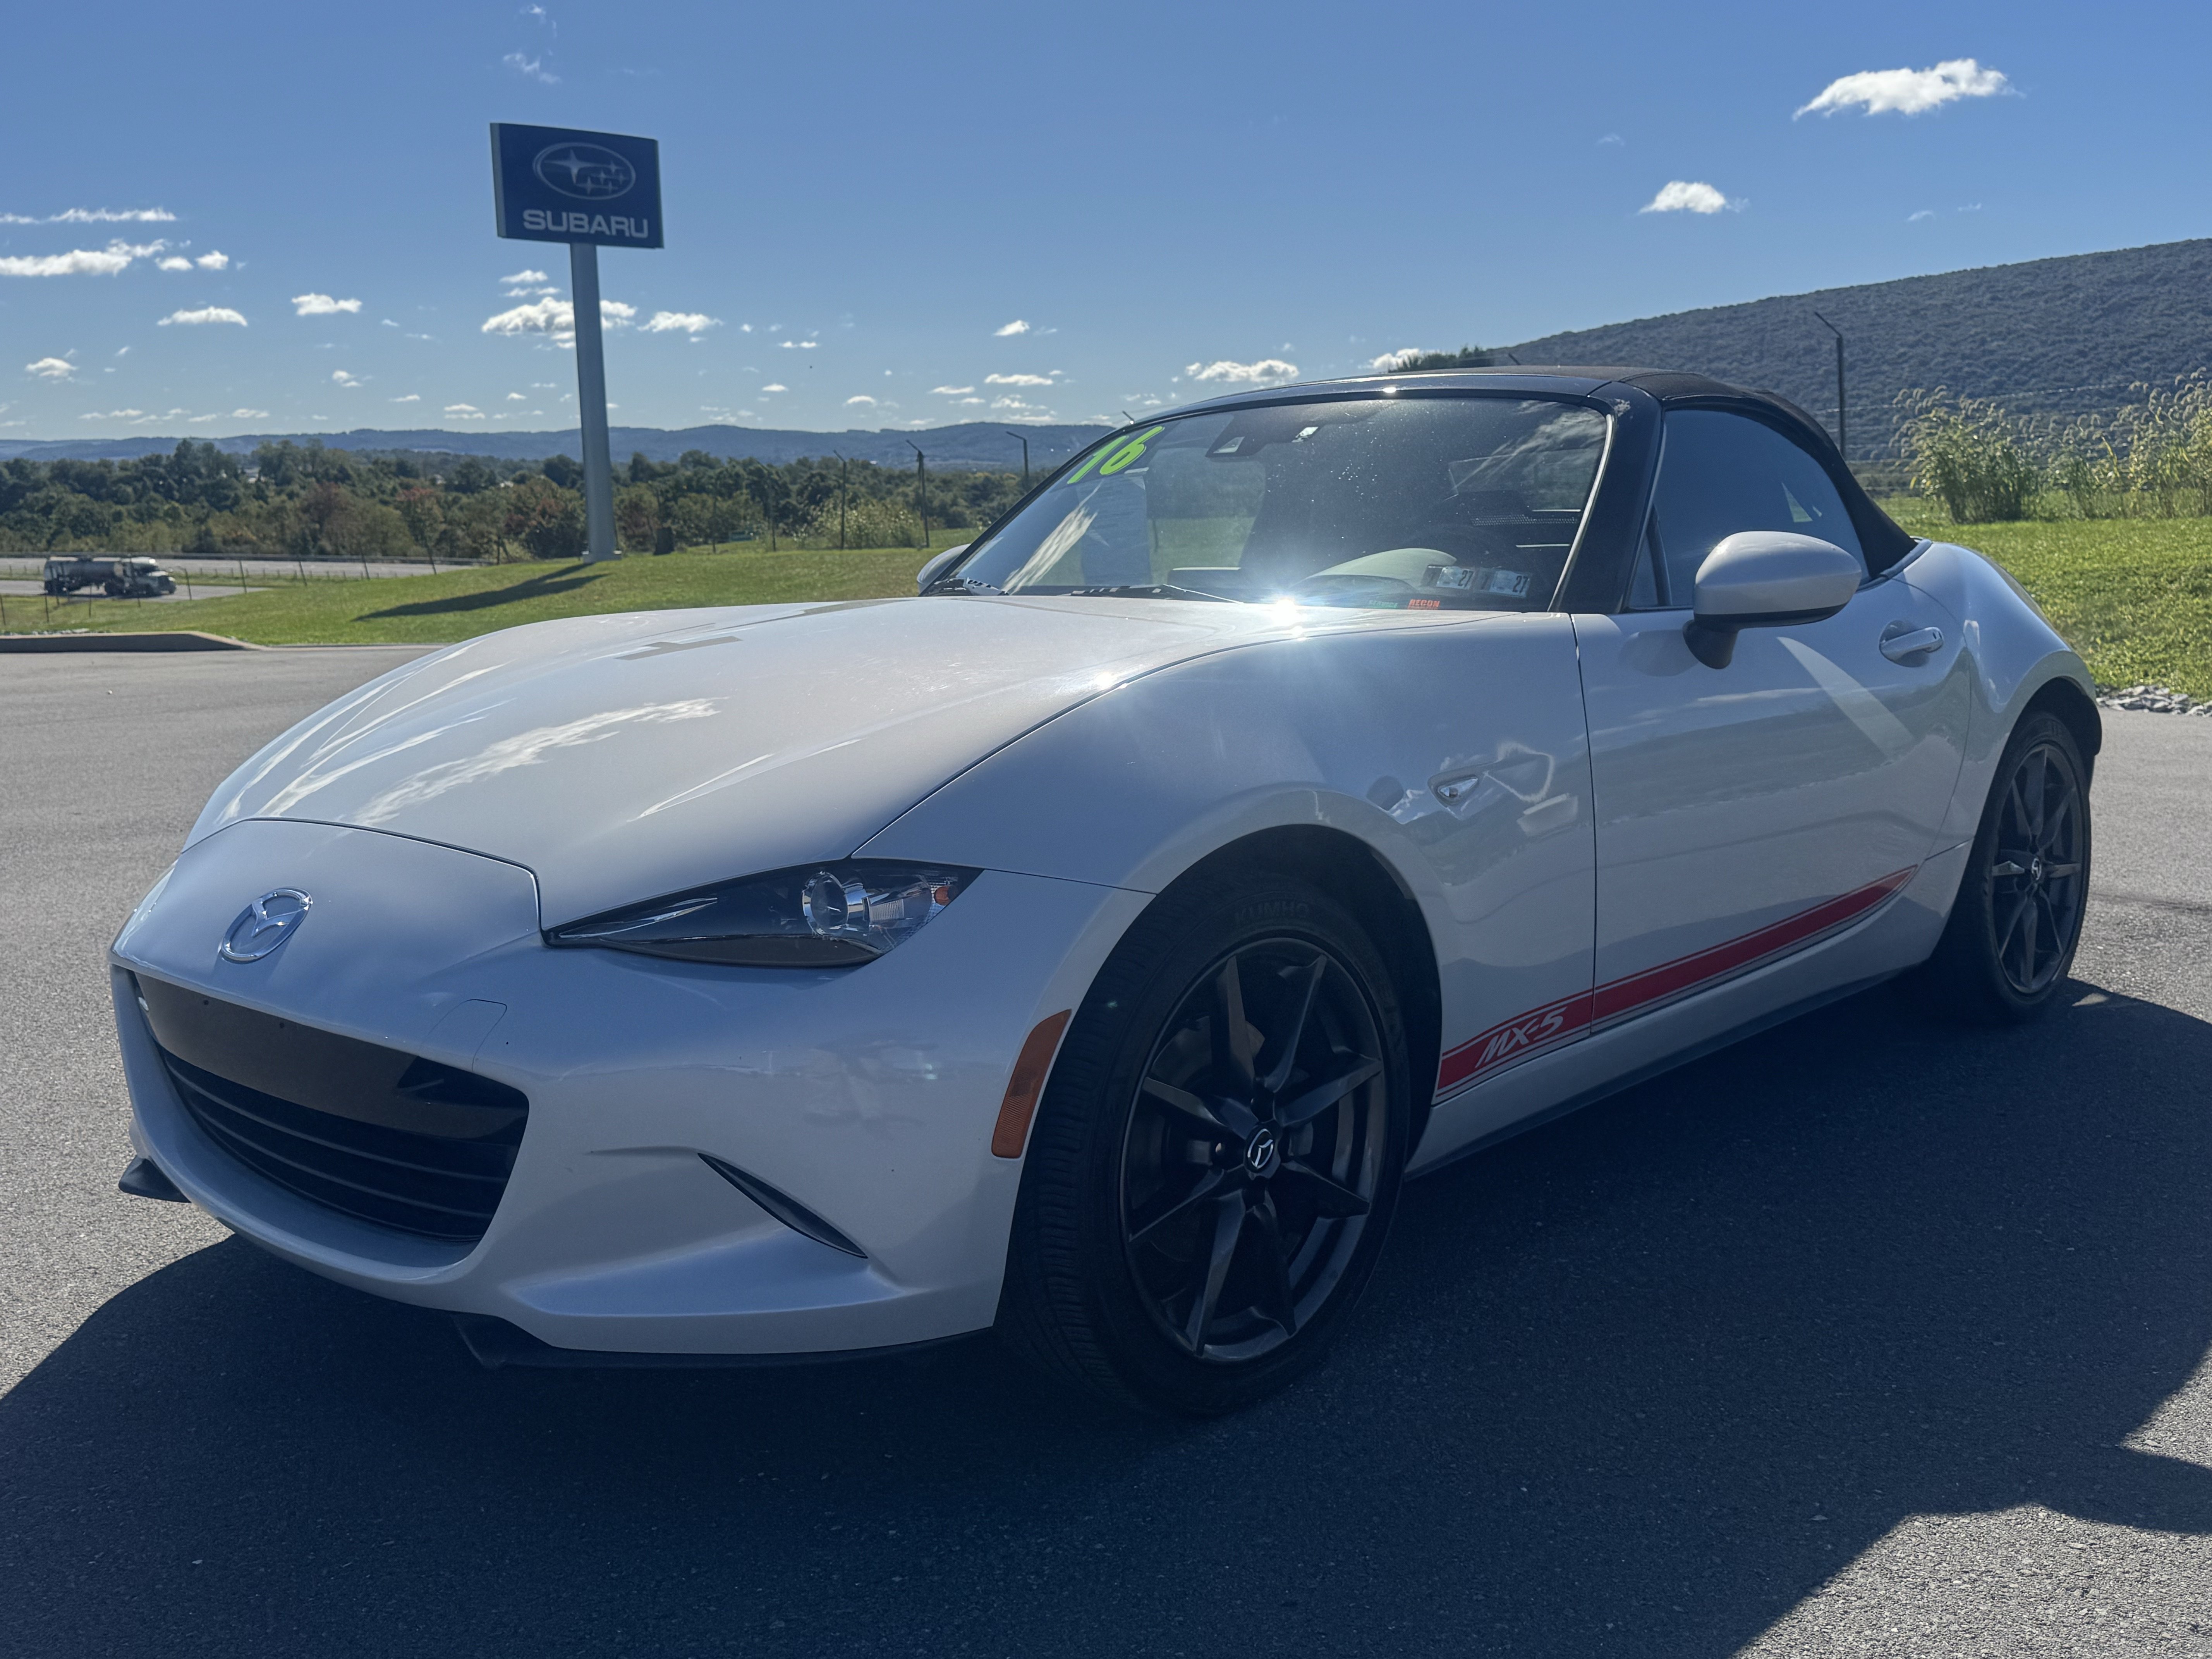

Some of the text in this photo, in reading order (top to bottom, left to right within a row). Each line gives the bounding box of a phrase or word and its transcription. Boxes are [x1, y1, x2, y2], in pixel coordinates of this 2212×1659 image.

[523, 210, 648, 238] SUBARU
[1067, 426, 1164, 484] 16
[1458, 570, 1474, 588] 27
[1512, 575, 1528, 594] 27
[1409, 599, 1440, 608] RECON
[1233, 900, 1309, 924] KUMHO
[1475, 1006, 1568, 1068] MX-5
